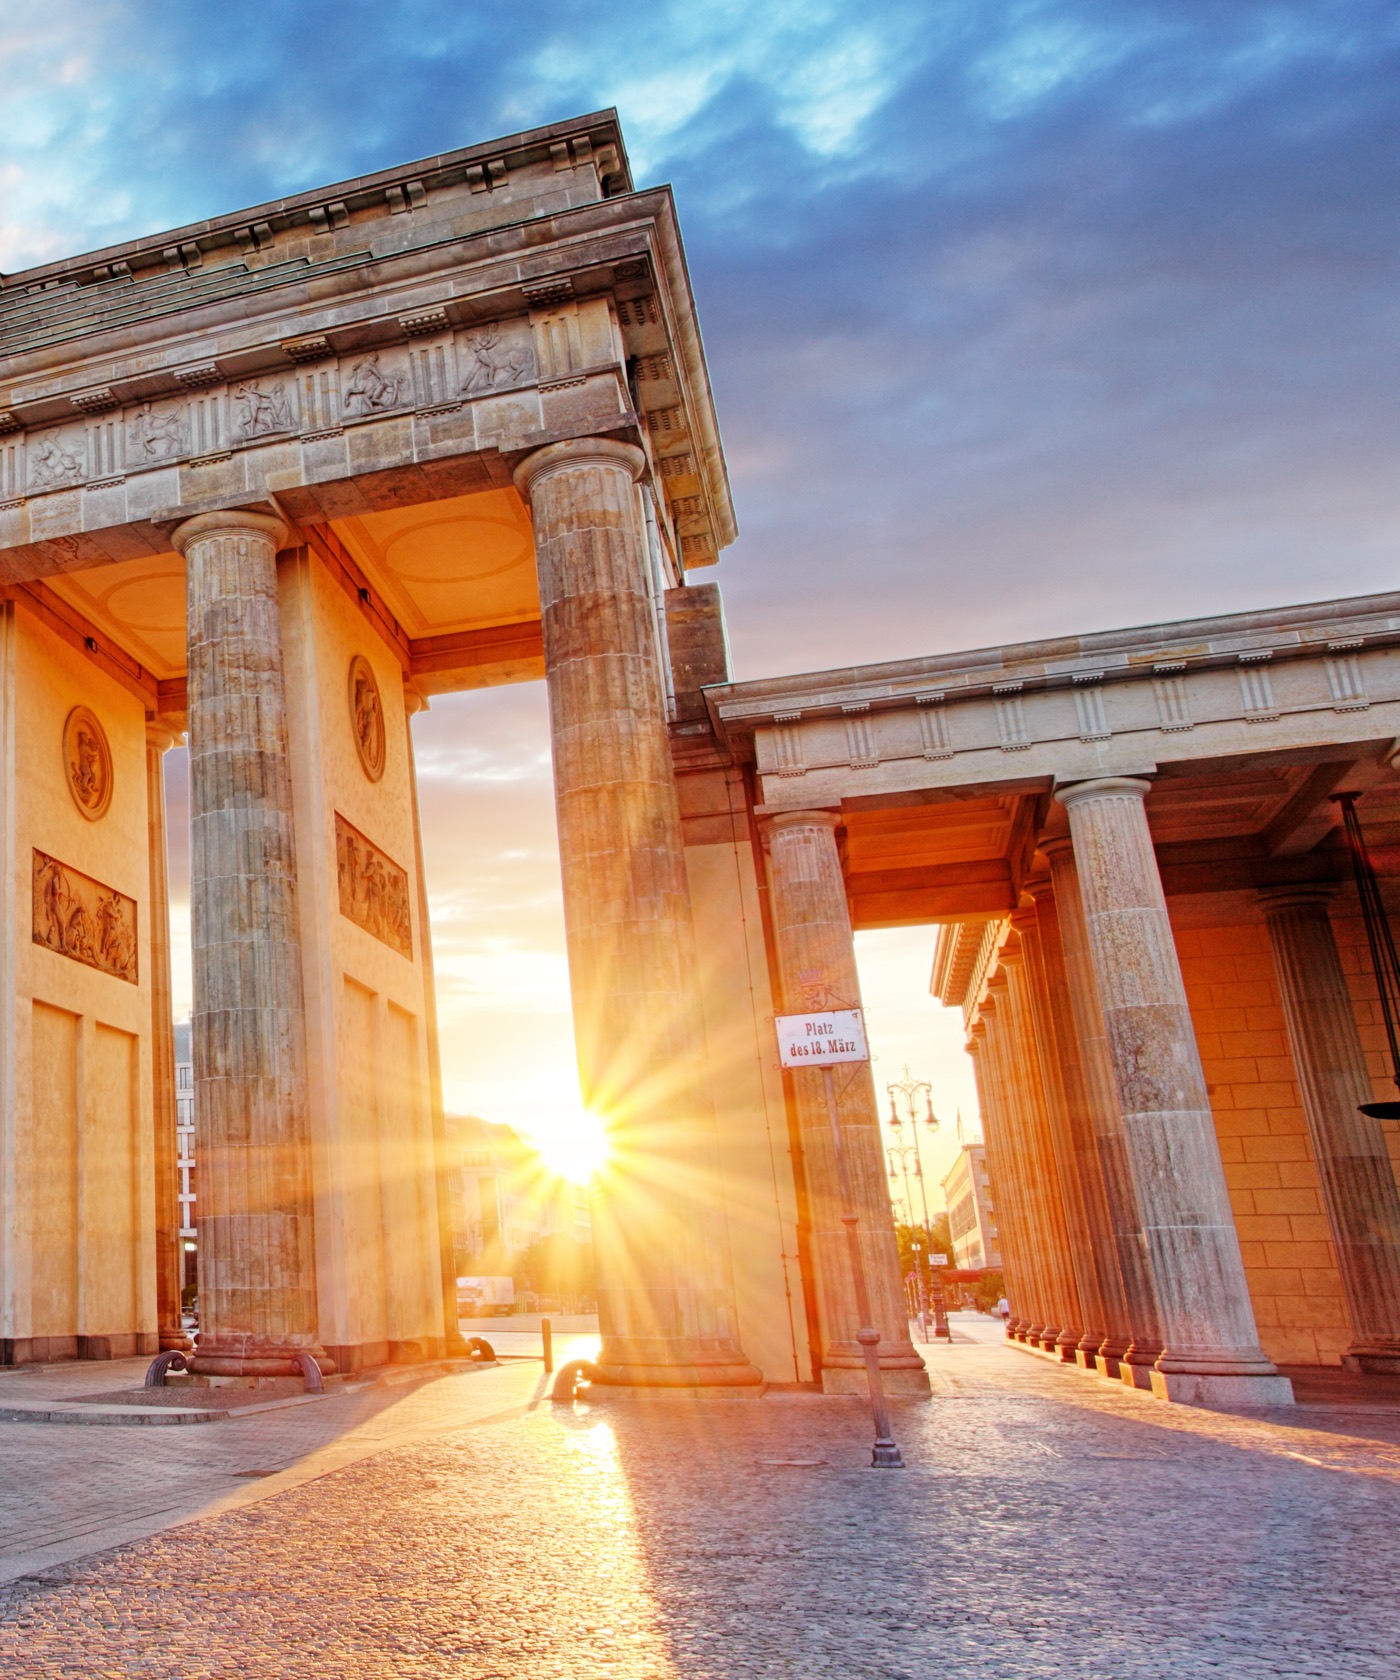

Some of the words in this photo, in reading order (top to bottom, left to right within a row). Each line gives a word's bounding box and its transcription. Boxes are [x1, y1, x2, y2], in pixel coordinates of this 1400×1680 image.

[805, 1022, 834, 1036] Platz
[790, 1043, 809, 1057] des
[810, 1041, 826, 1055] 18.
[827, 1038, 856, 1054] März
